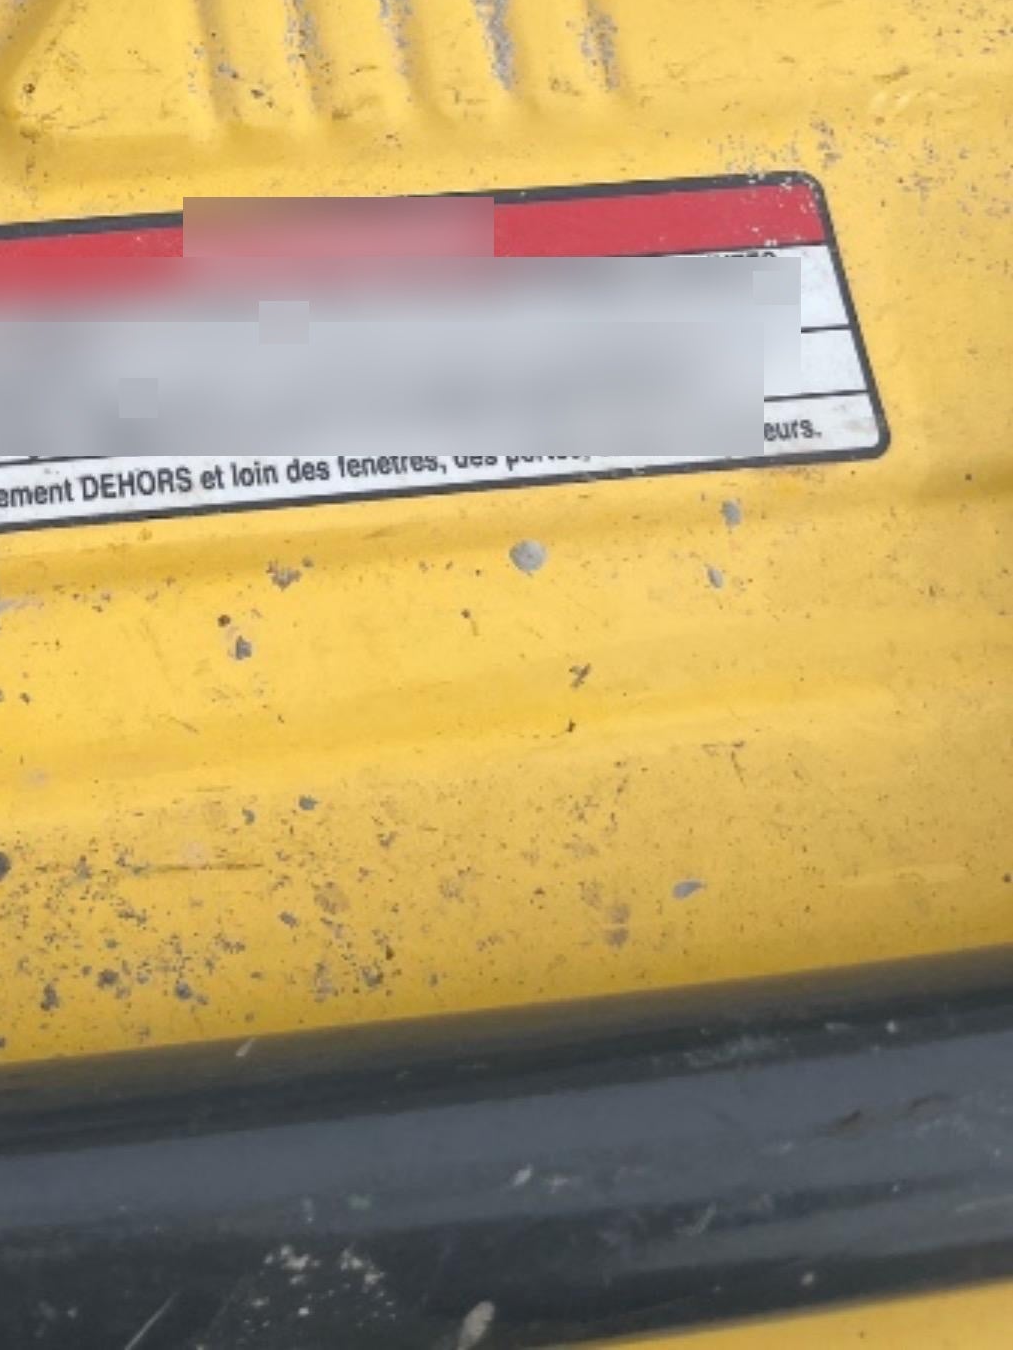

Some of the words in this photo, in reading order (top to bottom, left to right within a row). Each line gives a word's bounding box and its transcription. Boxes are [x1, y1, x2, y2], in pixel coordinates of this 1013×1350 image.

[81, 467, 192, 501] DEHORS
[200, 467, 226, 491] et
[231, 462, 278, 487] loin
[287, 456, 330, 482] des
[764, 418, 822, 442] eurs.
